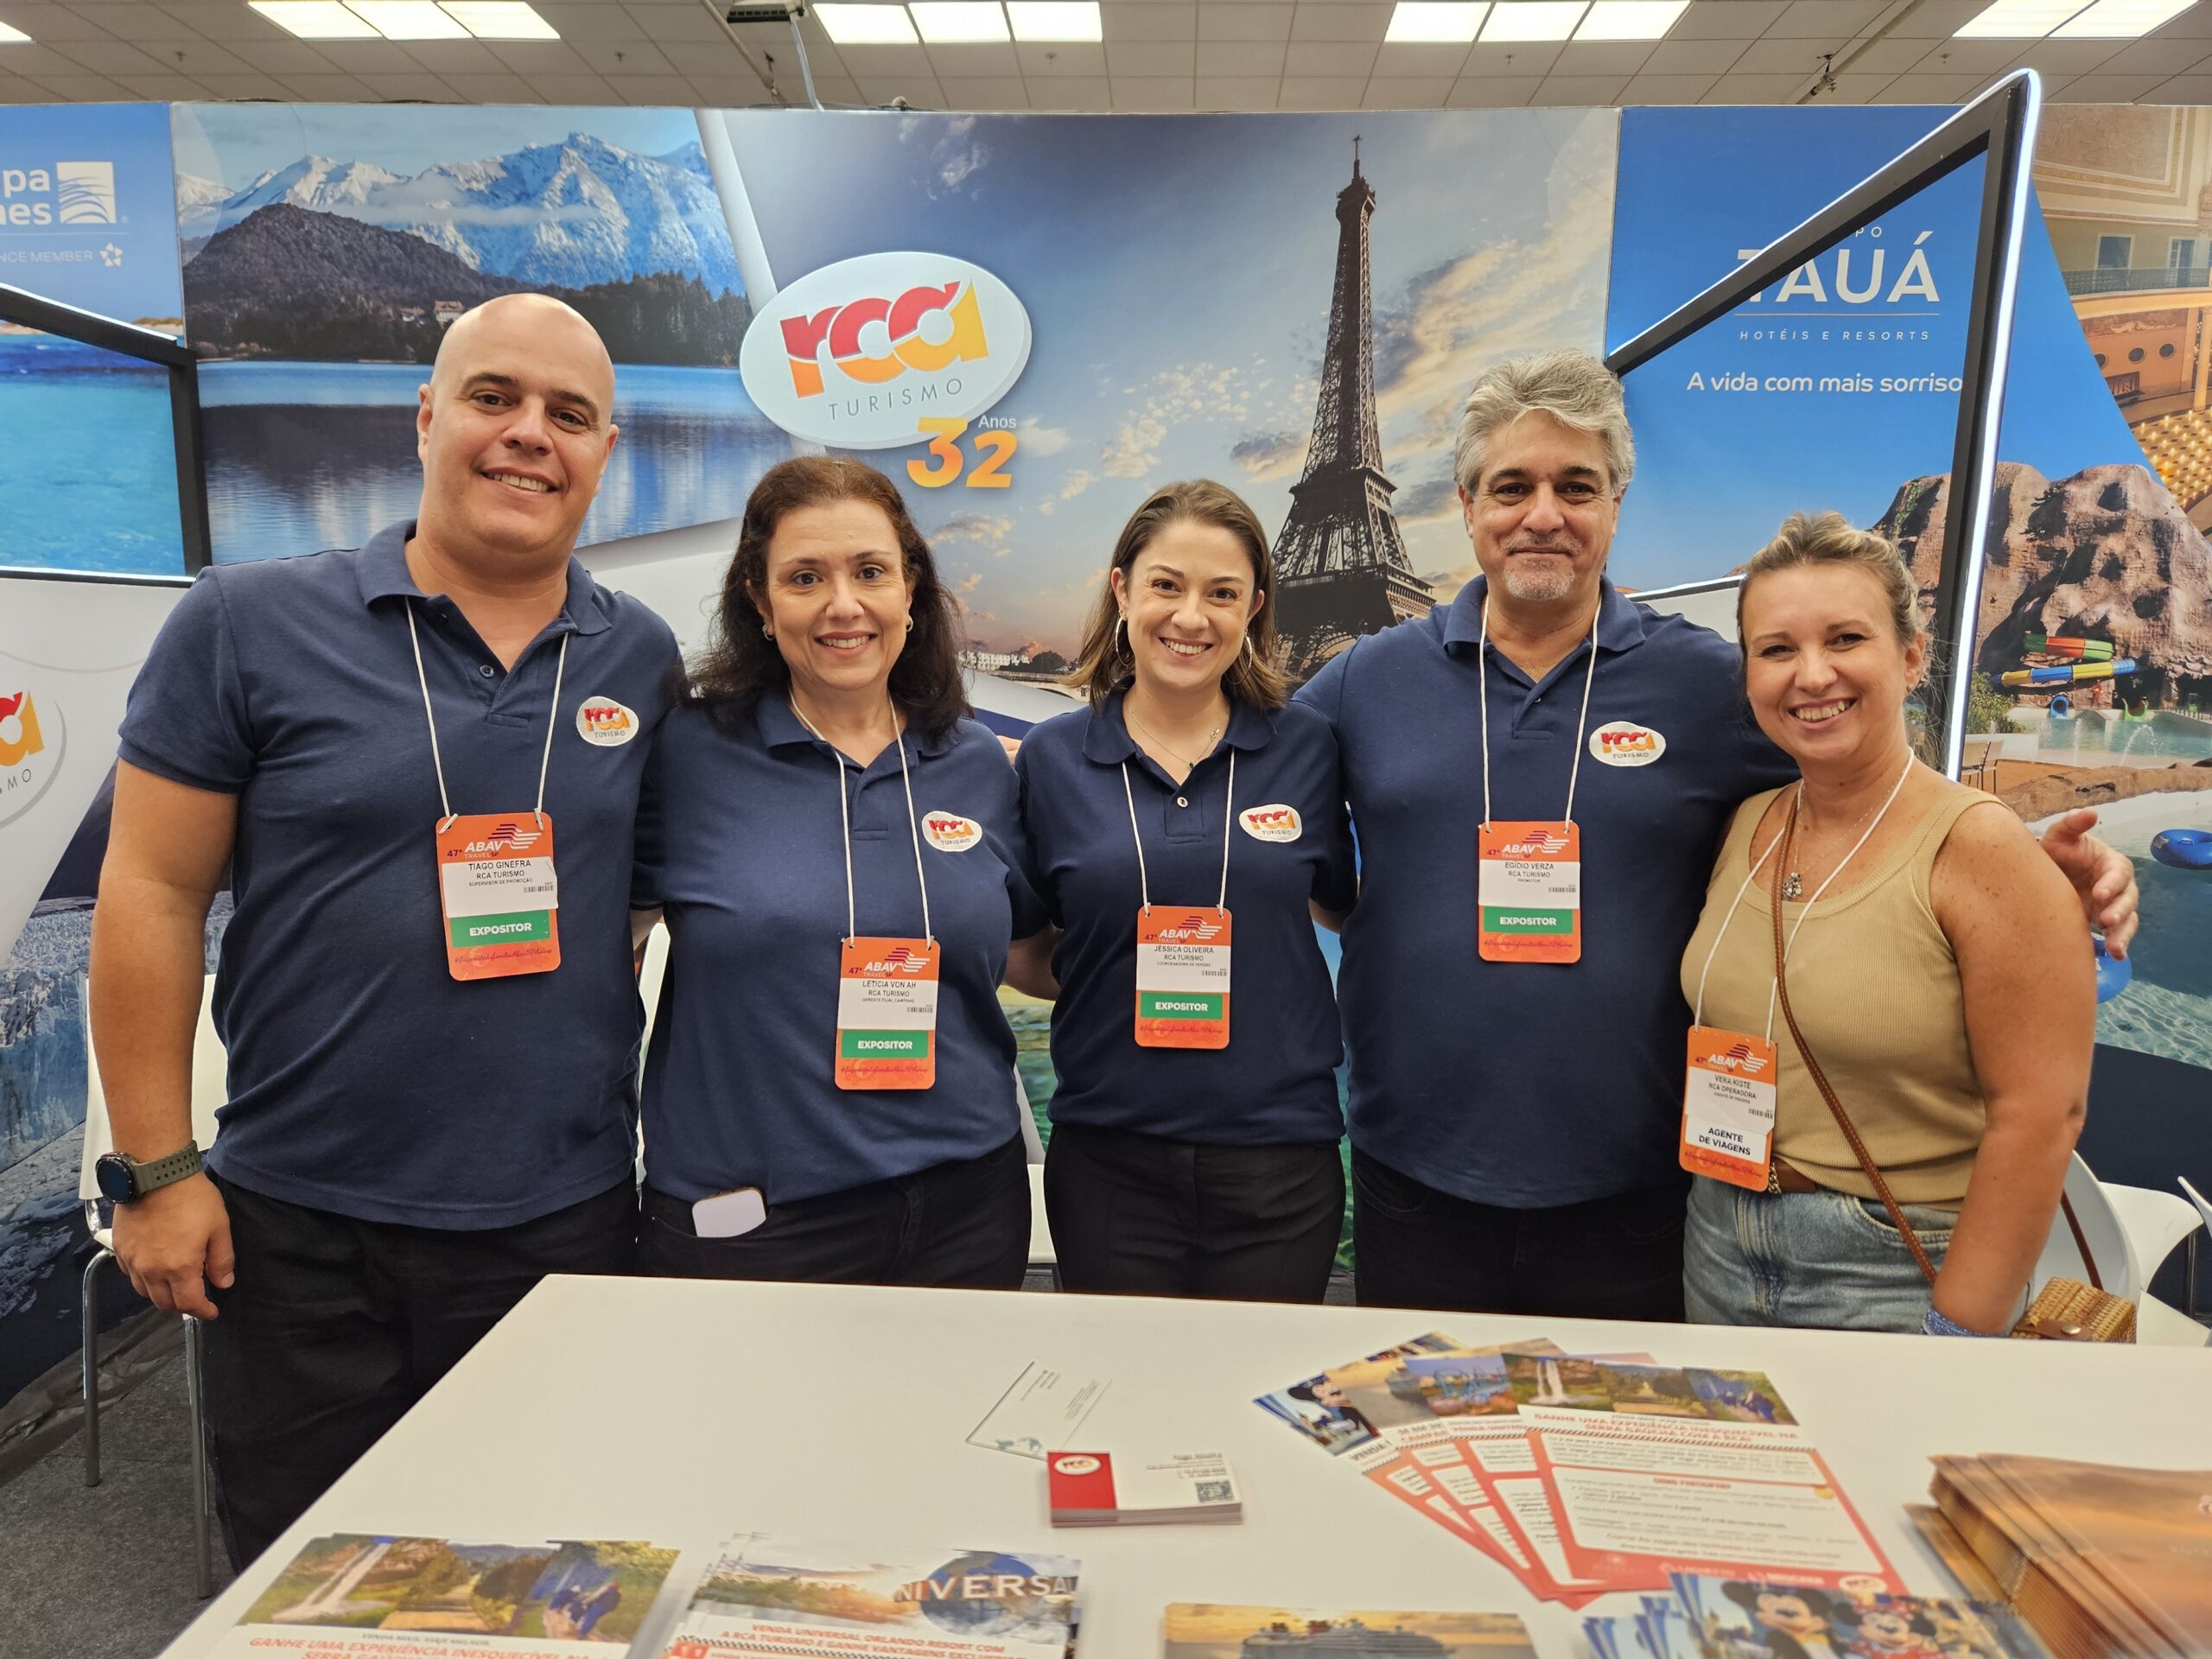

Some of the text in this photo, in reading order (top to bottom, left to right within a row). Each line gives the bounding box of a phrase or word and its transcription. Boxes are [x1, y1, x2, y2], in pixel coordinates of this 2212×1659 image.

[31, 250, 93, 262] MEMBER
[779, 279, 989, 399] rca
[1739, 328, 1929, 340] HOTÉIS E RESORTS
[1687, 372, 1705, 391] A
[1711, 372, 1758, 391] vida
[1764, 376, 1813, 391] com
[1819, 373, 1873, 392] mais
[829, 378, 963, 421] TURISMO
[978, 416, 1017, 429] Anos
[906, 417, 1019, 488] 32
[464, 840, 505, 853] ABAV
[1502, 844, 1536, 854] ABAV
[468, 860, 531, 871] TIAGO GINEFRA
[1499, 917, 1557, 926] EXPOSITOR
[469, 922, 532, 937] EXPOSITOR
[1159, 929, 1192, 939] ABAV
[863, 961, 898, 972] ABAV
[1155, 1001, 1208, 1012] EXPOSITOR
[857, 1040, 912, 1050] EXPOSITOR
[1707, 1054, 1738, 1069] ABAV
[1714, 1075, 1751, 1090] VERA KISTE
[1720, 1085, 1757, 1099] OPERADORA
[1707, 1127, 1744, 1142] AGENTE
[1699, 1135, 1751, 1155] DE VIAGENS
[732, 1631, 756, 1641] RCA
[760, 1634, 814, 1645] TURISMO
[753, 1624, 1005, 1653] VENDA UNIVERSAL ORLANDO RESORT COM
[250, 1637, 305, 1649] GANHE
[307, 1640, 345, 1650] UMA
[347, 1642, 448, 1656] EXPERIÊNCIA
